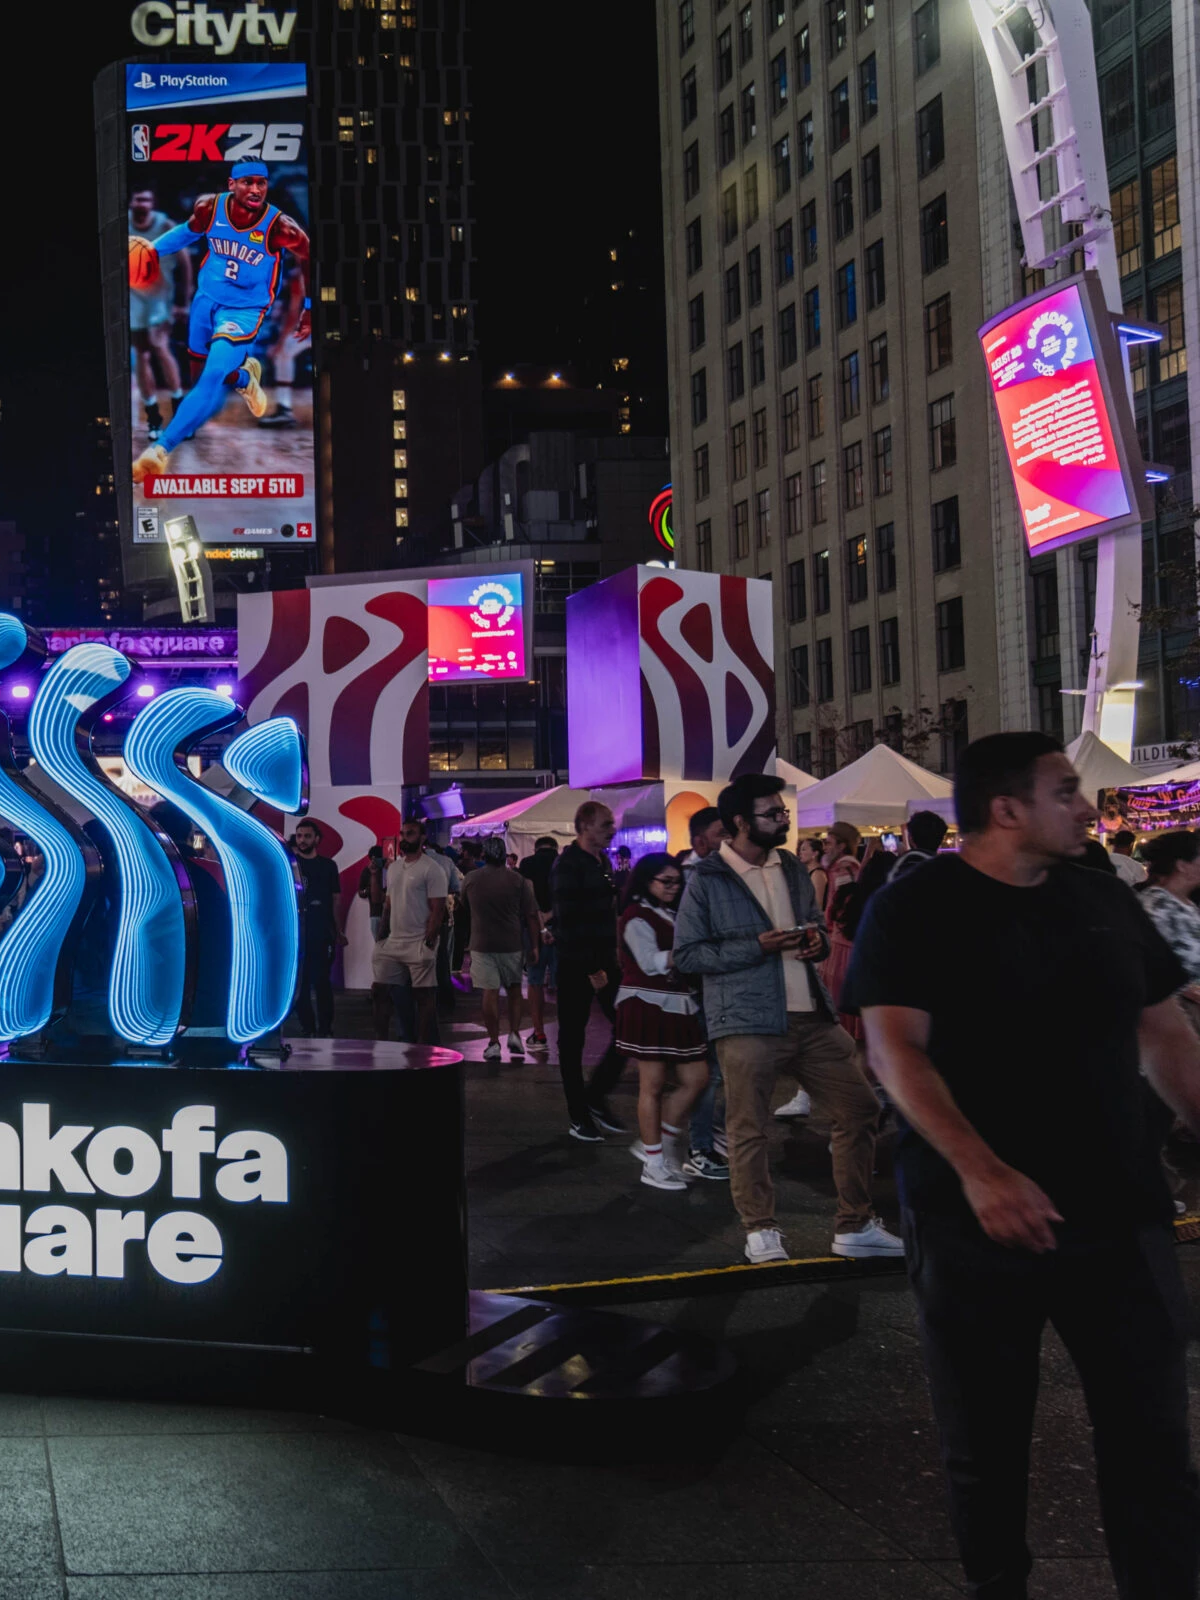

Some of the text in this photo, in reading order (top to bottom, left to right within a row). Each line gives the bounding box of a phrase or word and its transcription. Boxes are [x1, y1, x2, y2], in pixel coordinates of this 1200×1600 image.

[130, 0, 297, 56] Citytv
[160, 74, 228, 89] PlayStation
[150, 123, 303, 163] 2K26
[209, 237, 265, 267] THUNDER
[225, 260, 239, 281] 2
[1032, 357, 1056, 378] 2025
[152, 477, 296, 495] AVAILABLE SEPT 5TH
[141, 518, 155, 533] E
[205, 549, 258, 561] ndedcities
[139, 634, 225, 656] square
